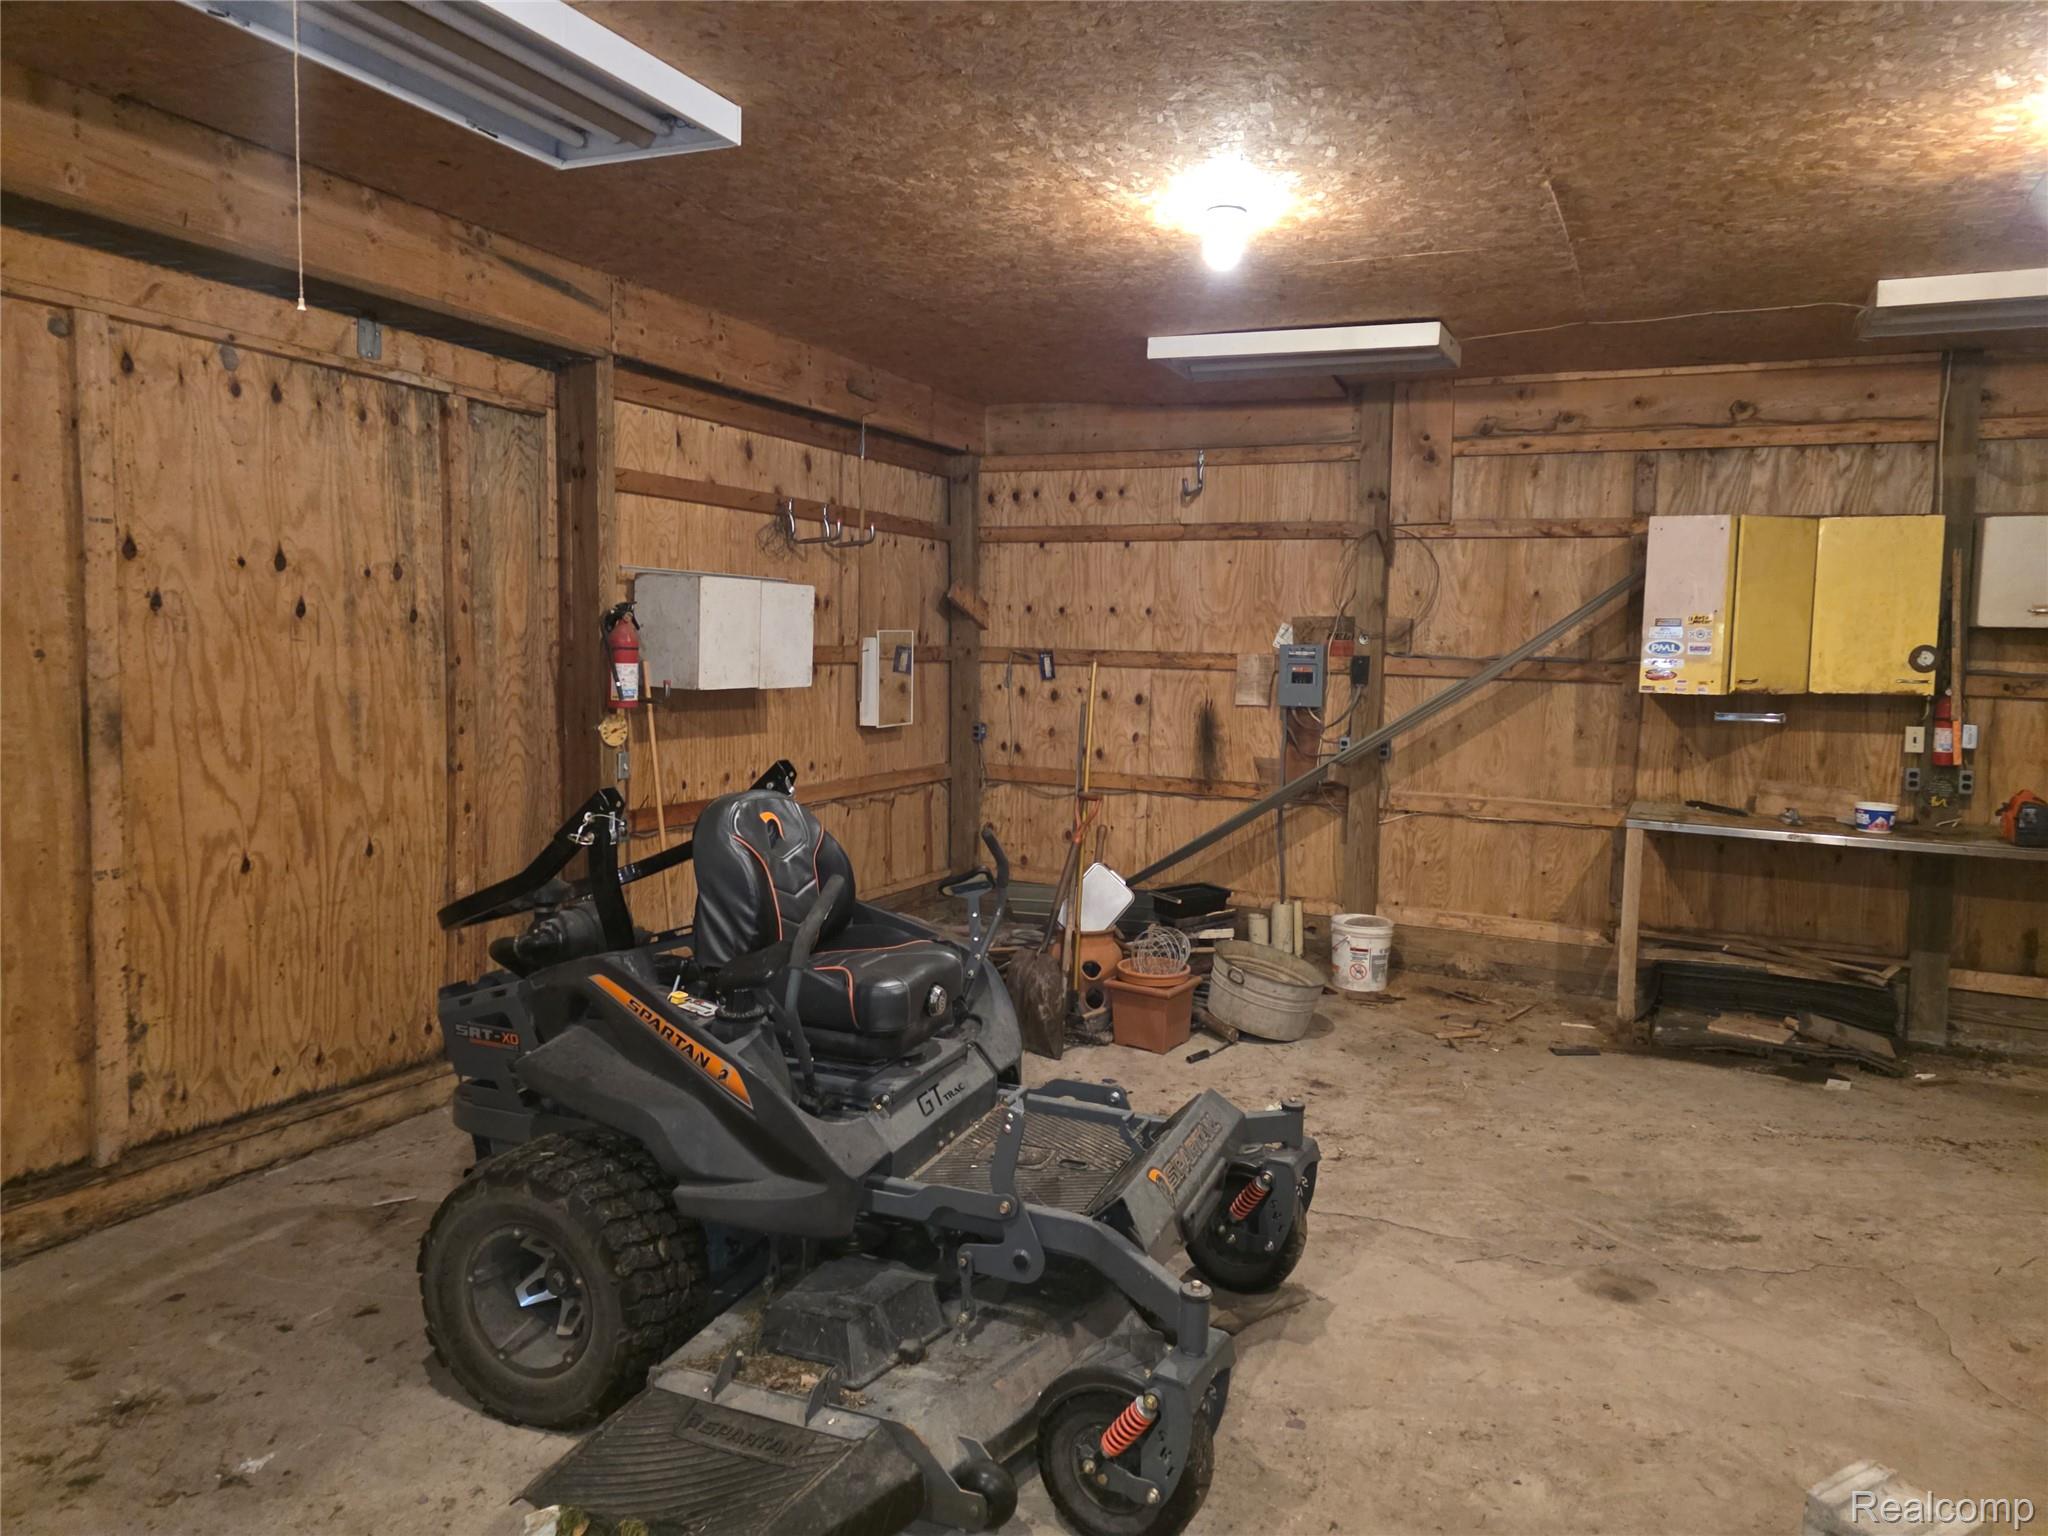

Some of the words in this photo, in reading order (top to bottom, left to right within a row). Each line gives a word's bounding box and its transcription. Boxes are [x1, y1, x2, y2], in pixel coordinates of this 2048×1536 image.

[625, 999, 710, 1068] SPARTAN
[916, 1083, 943, 1117] GT
[942, 1082, 966, 1102] TRAC
[1162, 1112, 1223, 1190] SPARTAN
[697, 1421, 803, 1456] SPARTAN
